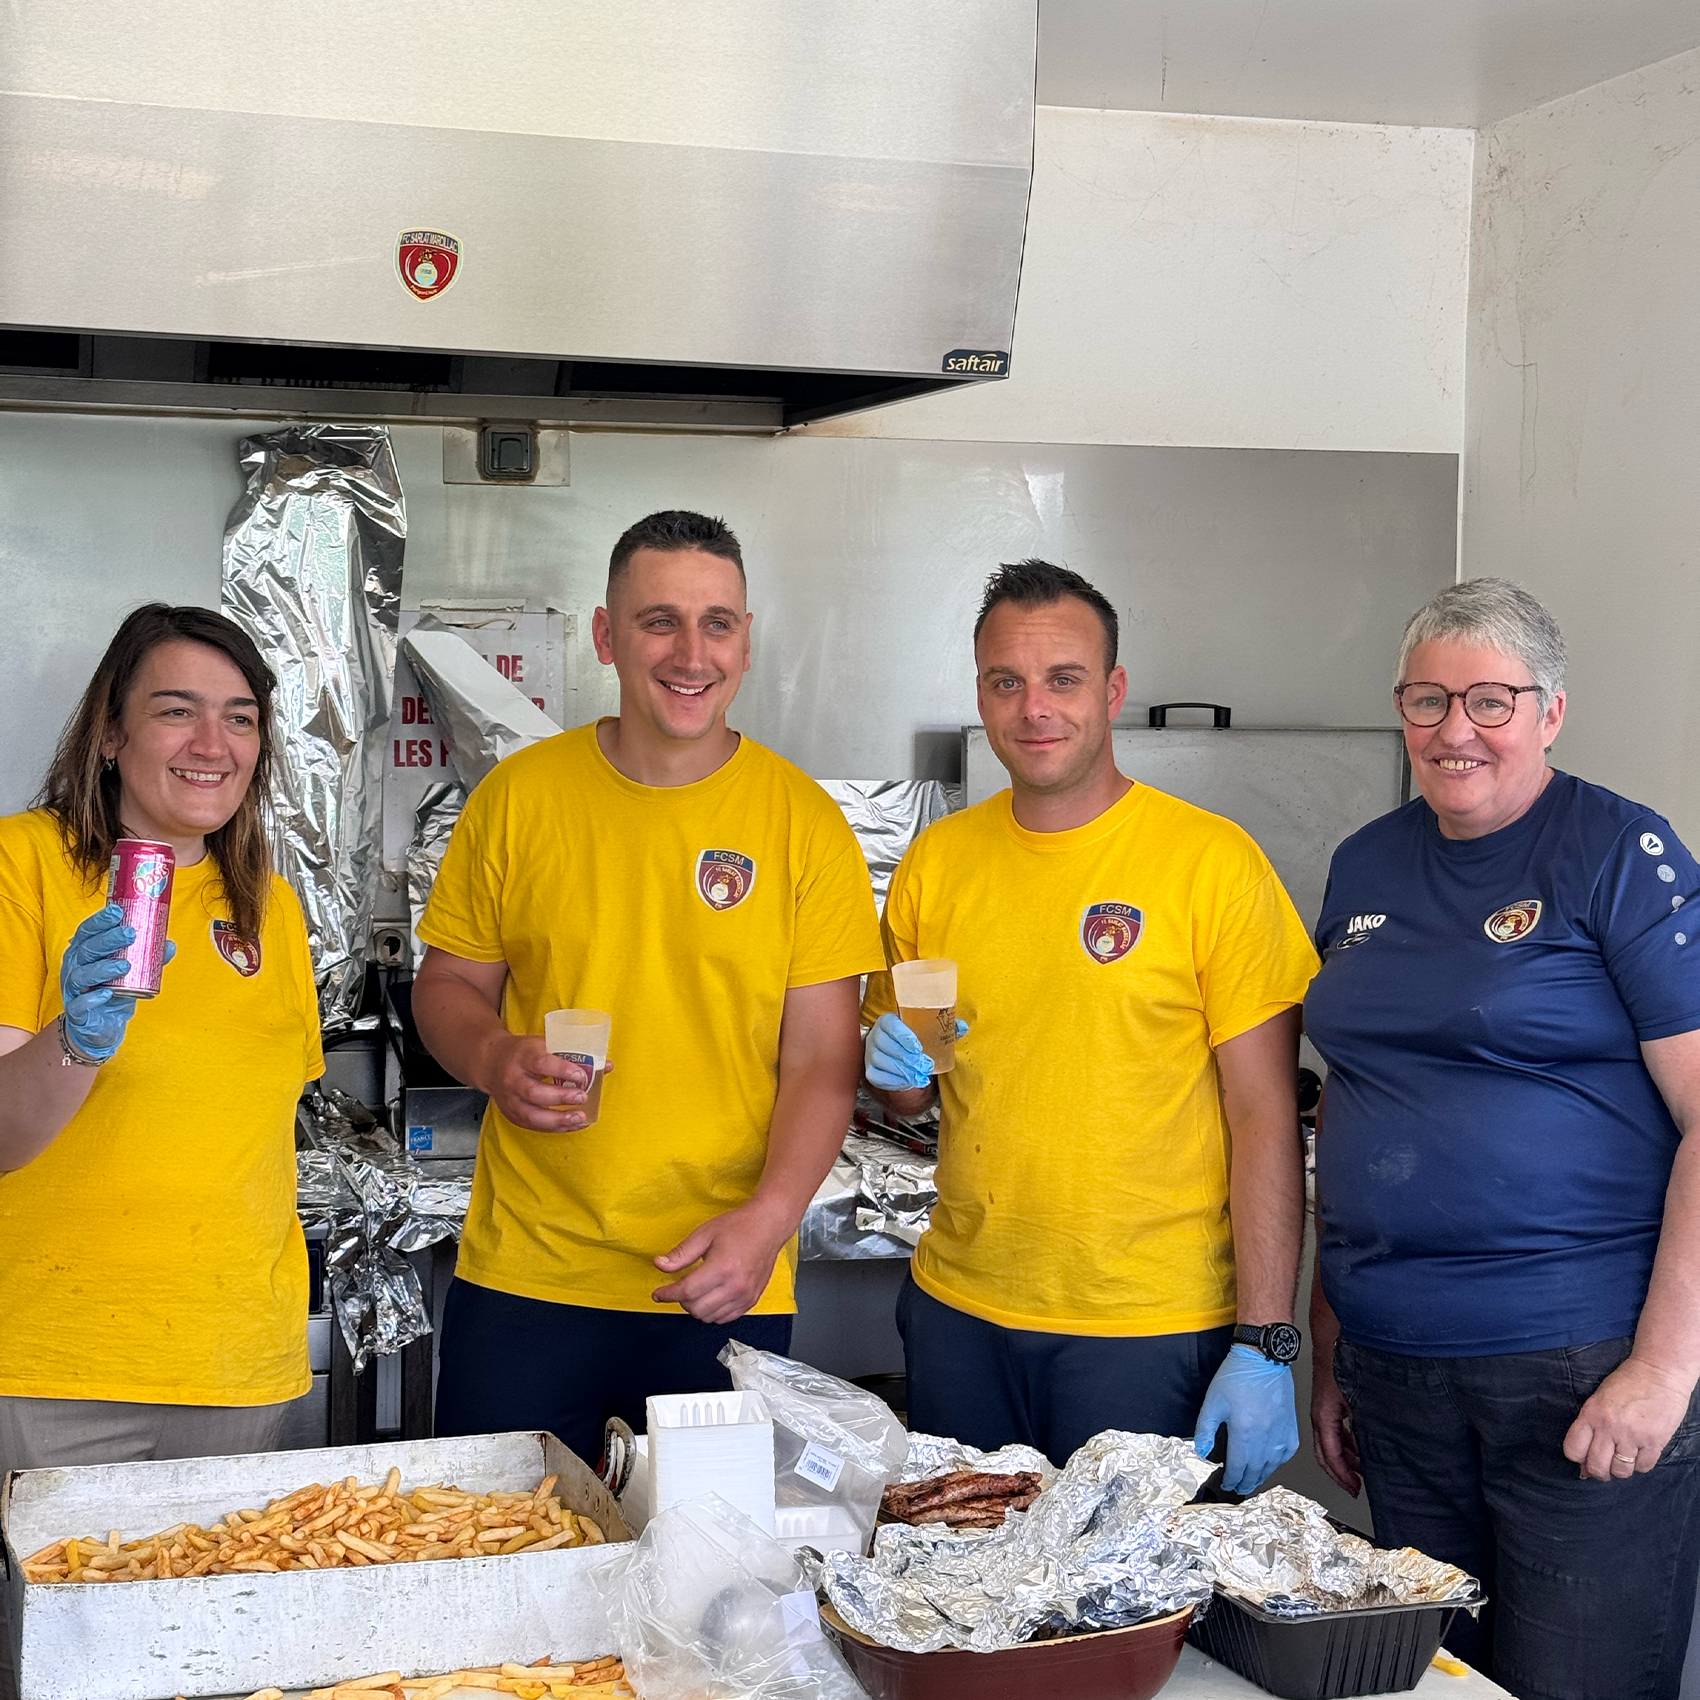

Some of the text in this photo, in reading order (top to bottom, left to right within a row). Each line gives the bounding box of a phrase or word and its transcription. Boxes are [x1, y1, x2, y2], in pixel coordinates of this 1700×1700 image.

[946, 354, 1004, 372] saftair
[496, 655, 524, 682] DE
[393, 739, 432, 767] LES
[713, 851, 745, 866] FCSM
[1099, 904, 1132, 917] FCSM
[1346, 914, 1387, 934] JAKO
